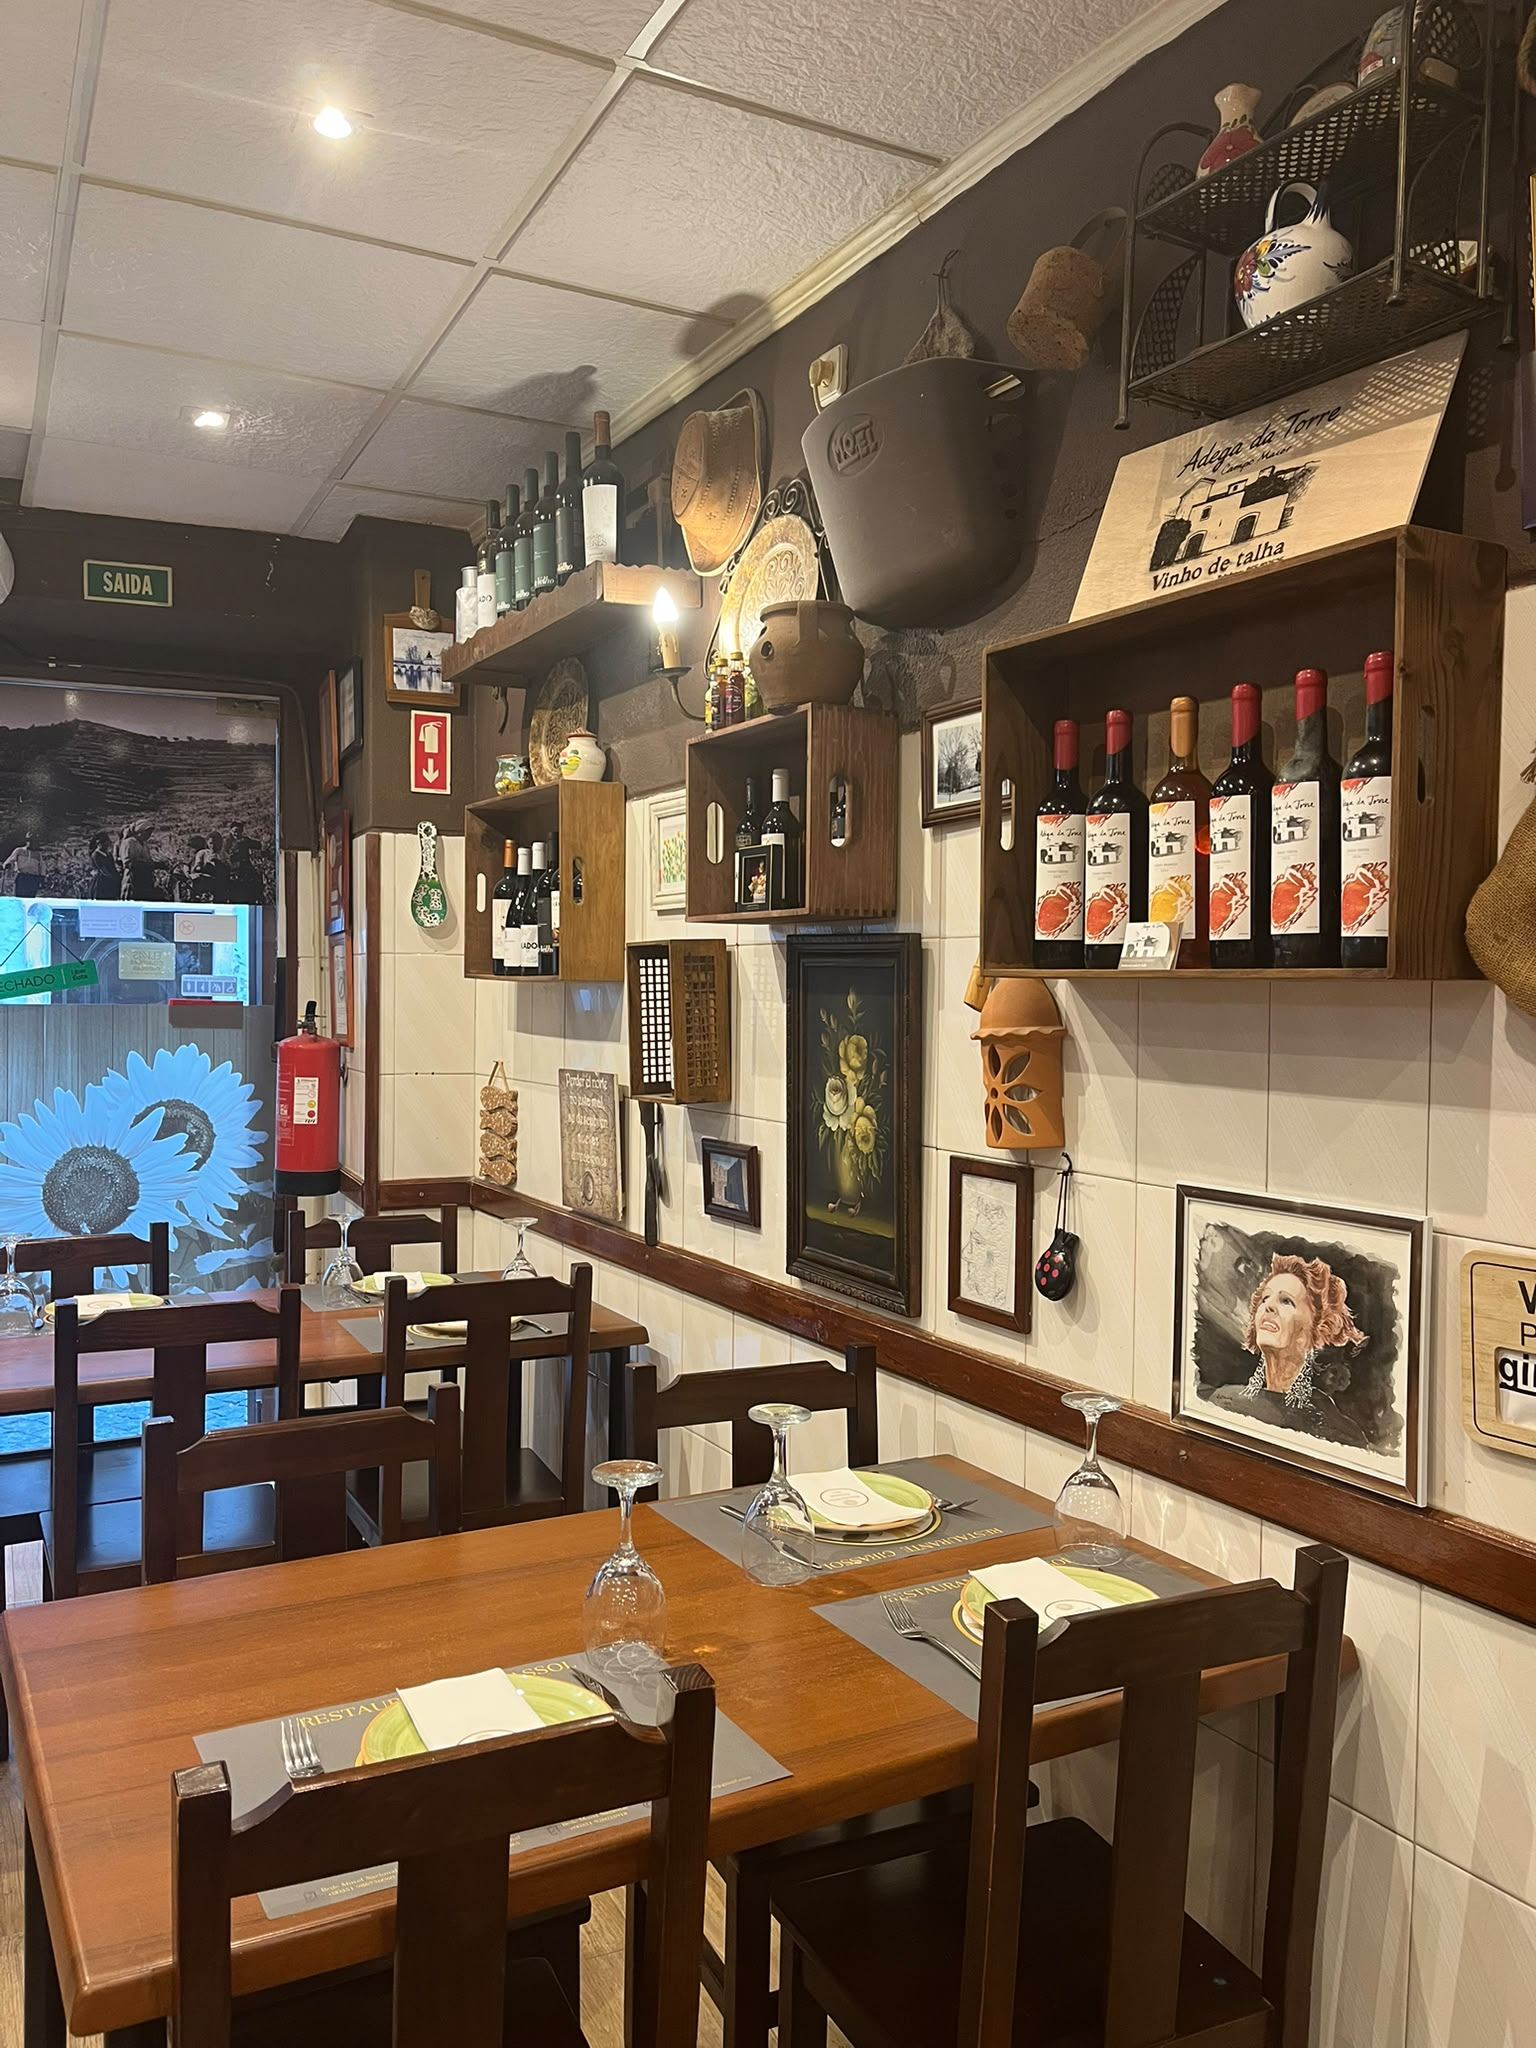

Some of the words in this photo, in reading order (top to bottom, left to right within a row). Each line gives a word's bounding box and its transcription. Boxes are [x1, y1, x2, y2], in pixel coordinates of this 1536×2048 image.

[1177, 441, 1243, 479] Adega
[1250, 423, 1276, 450] da
[1283, 406, 1342, 439] Torre
[102, 570, 153, 596] SAIDA
[1152, 565, 1203, 592] Vinho
[1207, 555, 1231, 576] de
[1236, 540, 1286, 568] talha
